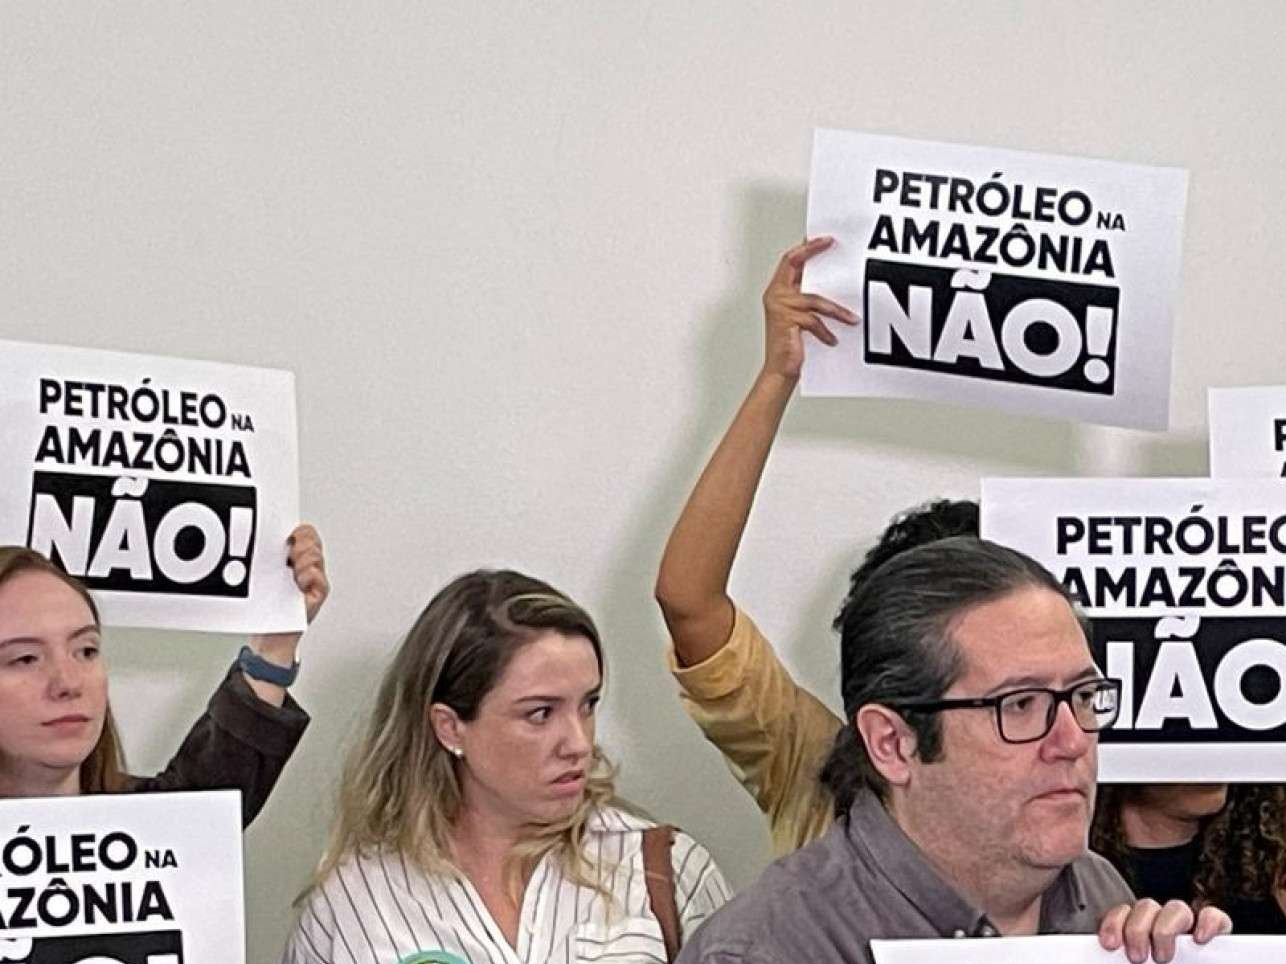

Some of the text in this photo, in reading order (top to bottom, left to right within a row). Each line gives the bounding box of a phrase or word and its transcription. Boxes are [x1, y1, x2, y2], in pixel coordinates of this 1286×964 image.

[872, 168, 1126, 231] PETRÓLEO NA
[867, 214, 1116, 278] AMAZÔNIA
[867, 268, 1115, 385] NÃO!
[39, 377, 255, 433] PETRÓLEO NA
[34, 425, 252, 478] AMAZÔNIA
[31, 477, 254, 586] NÃO!
[0, 824, 179, 877] ÓLEO NA
